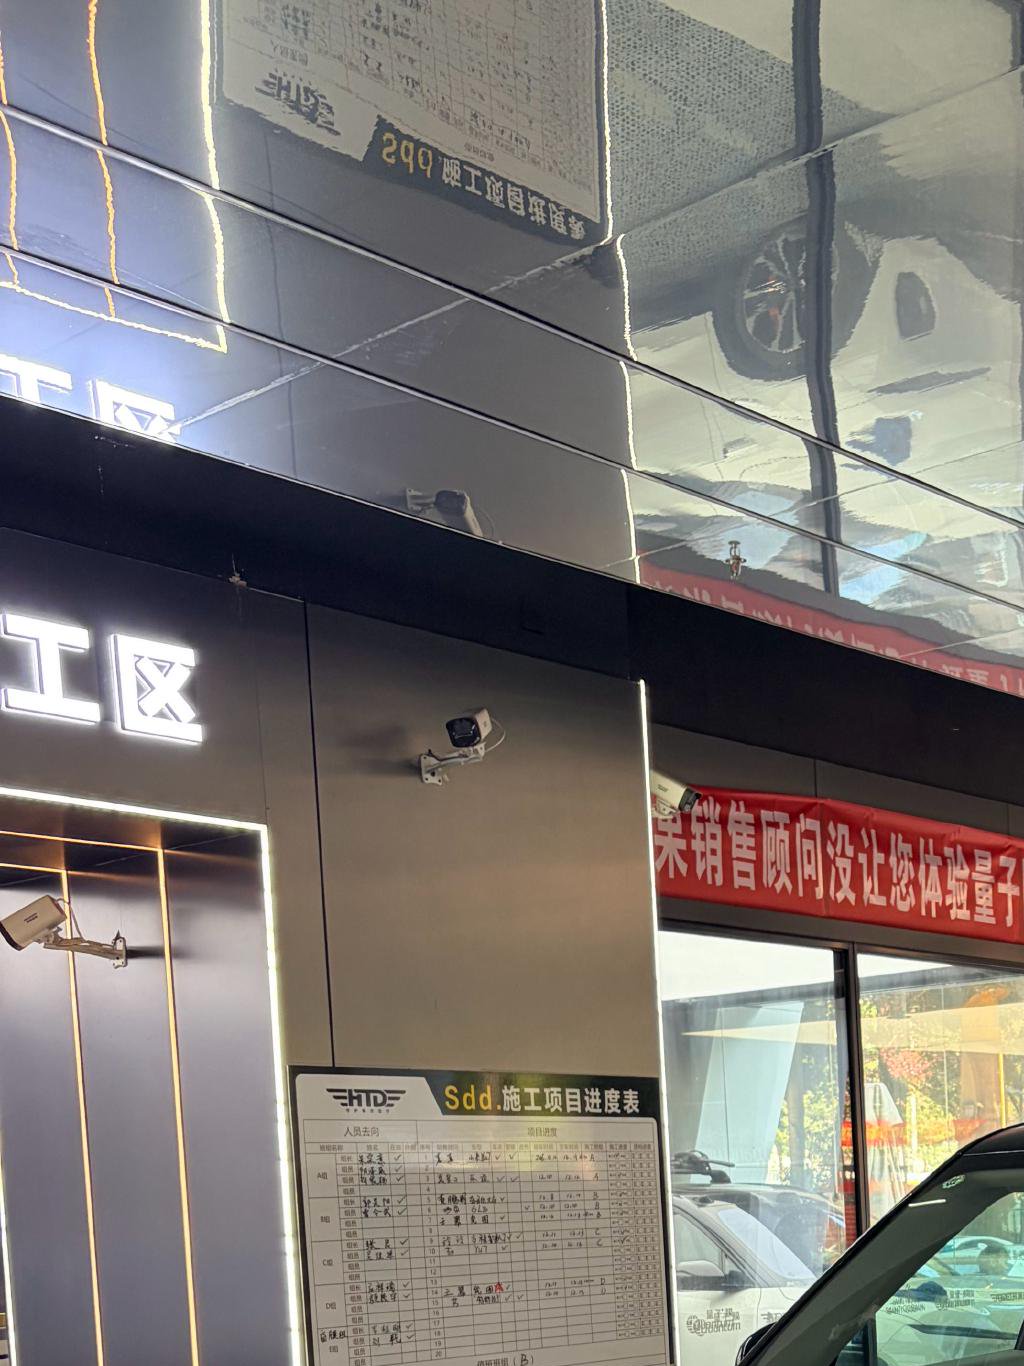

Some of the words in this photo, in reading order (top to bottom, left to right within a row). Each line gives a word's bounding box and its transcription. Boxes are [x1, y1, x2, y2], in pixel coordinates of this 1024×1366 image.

[0, 613, 203, 745] 工区
[344, 1127, 379, 1137] 人员去向
[528, 1127, 557, 1137] 项目进度
